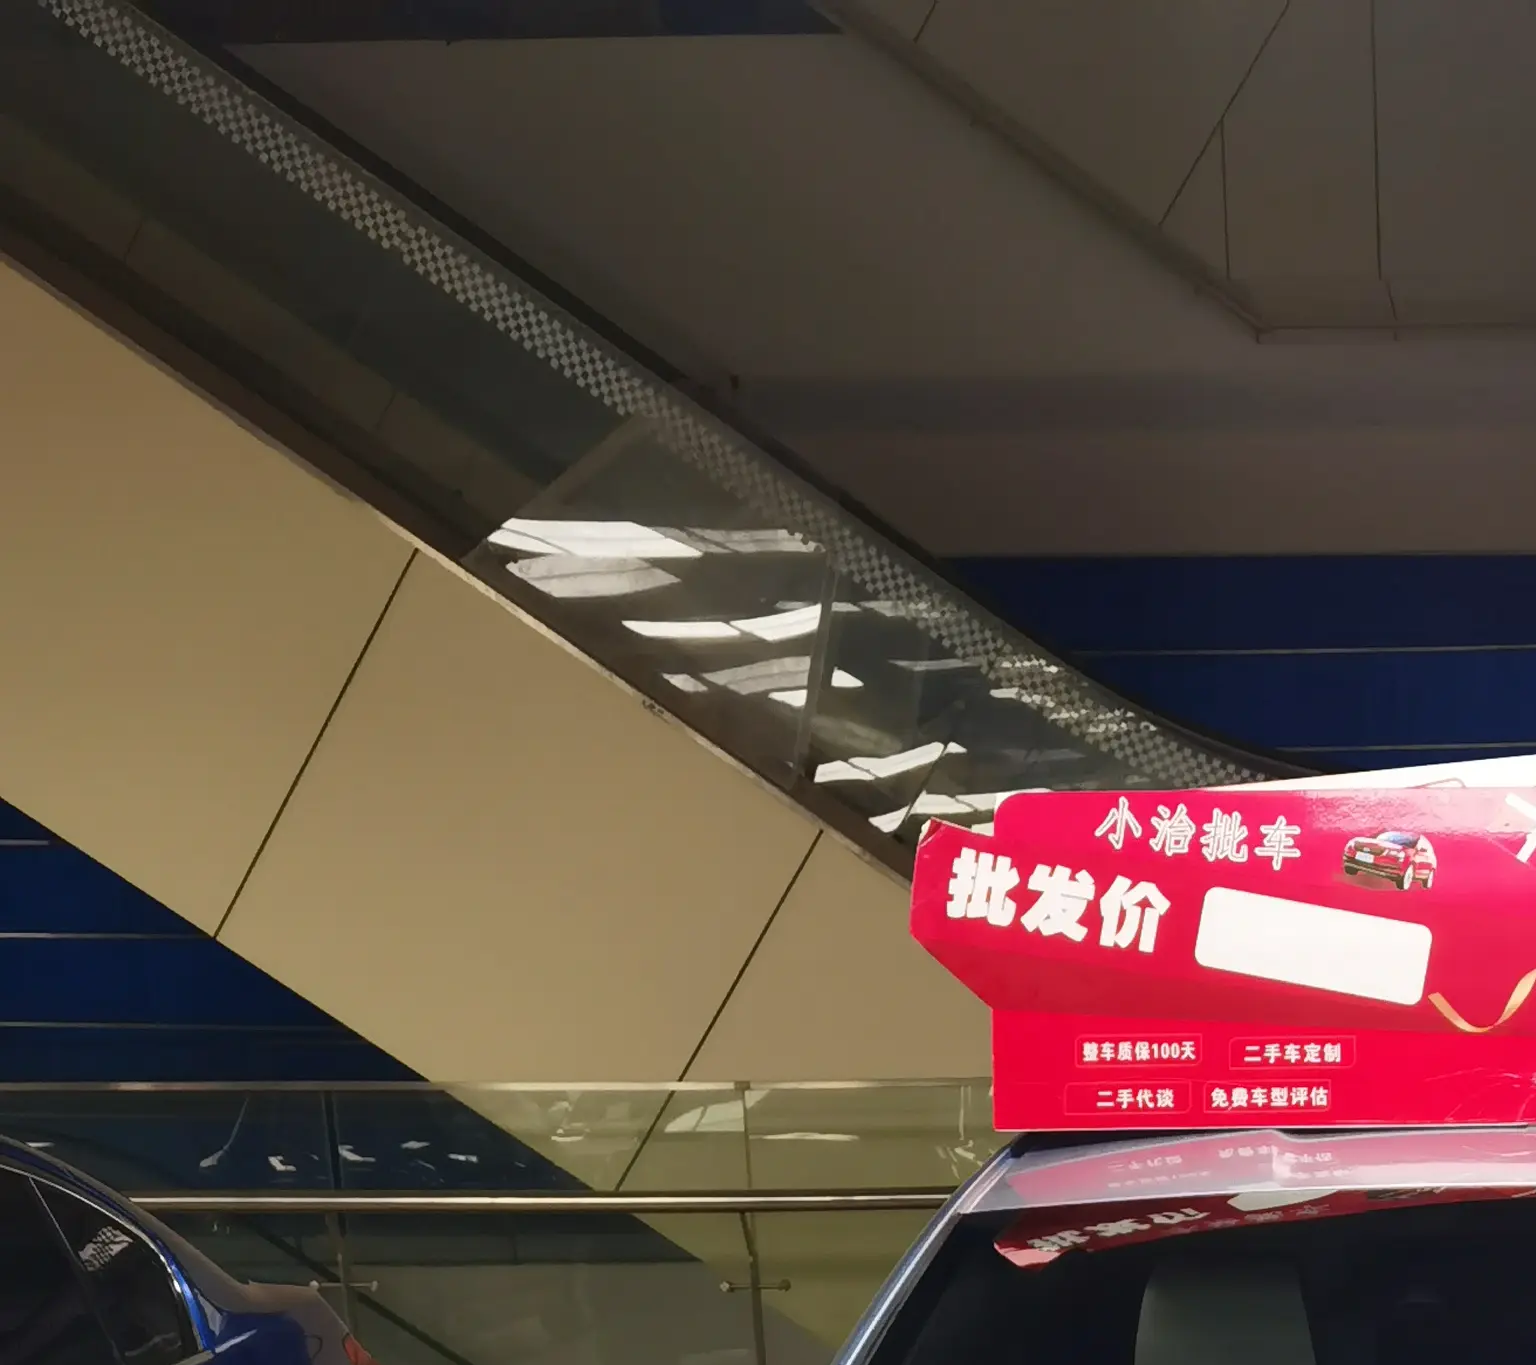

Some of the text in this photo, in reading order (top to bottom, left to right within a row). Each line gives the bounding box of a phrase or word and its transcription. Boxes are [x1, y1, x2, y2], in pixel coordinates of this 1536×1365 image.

[946, 847, 1171, 953] 批发价
[1082, 1040, 1197, 1063] 整车质保100天
[1243, 1042, 1342, 1064] 二手车定制
[1096, 1087, 1175, 1109] 二手代谈
[1210, 1086, 1329, 1109] 免费车型评估
